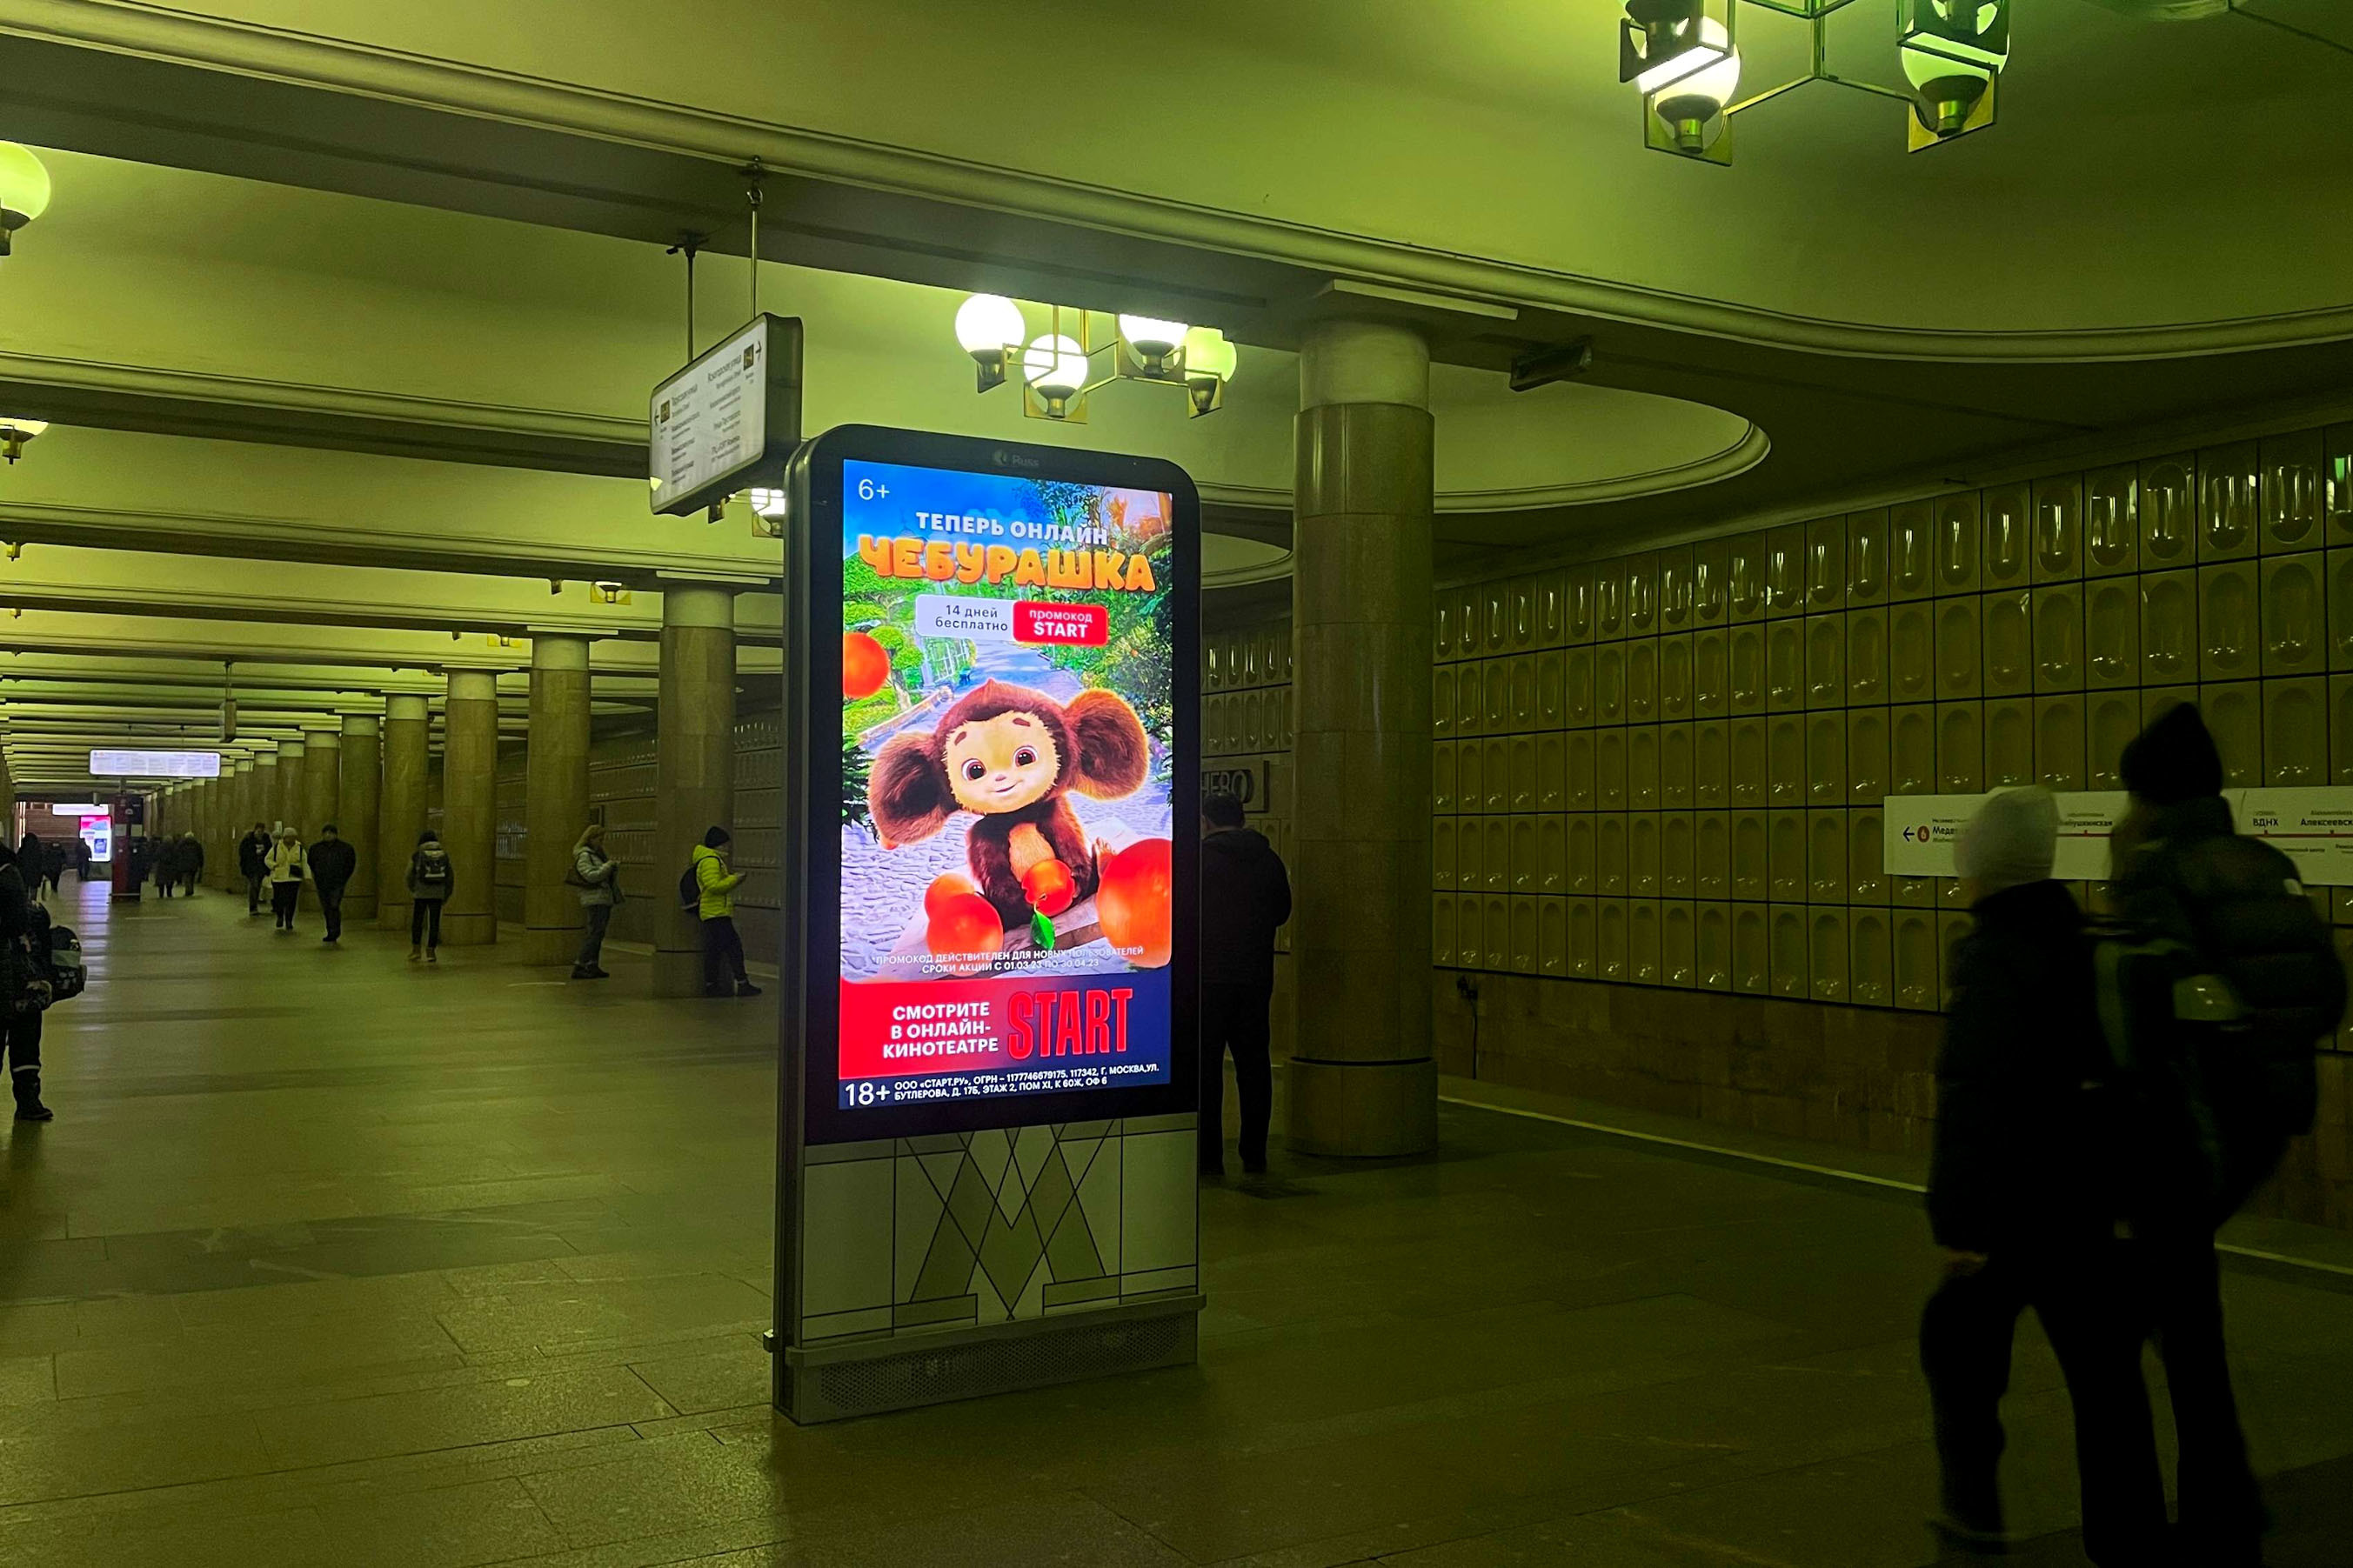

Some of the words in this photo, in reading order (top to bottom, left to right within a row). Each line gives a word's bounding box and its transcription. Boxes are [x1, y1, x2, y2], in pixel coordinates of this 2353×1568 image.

[859, 478, 891, 501] 6+
[916, 512, 1003, 536] ТЕПЕРЬ
[1010, 521, 1108, 545] ОНЛАЙН
[859, 536, 1157, 593] ЧЕБУРАШКА
[946, 604, 960, 617] 14
[965, 606, 999, 619] дней
[1029, 609, 1093, 624] промокод
[935, 616, 1008, 632] бесплатно
[1033, 624, 1089, 639] START
[2253, 817, 2279, 827] ВДНХ
[935, 951, 1010, 964] ДЕЙСТВИТЕЛЕН
[1012, 950, 1031, 961] ДЛЯ
[1033, 949, 1066, 960] НОВЫХ
[921, 964, 956, 974] СРОКИ
[959, 962, 993, 973] АКЦИИ
[994, 962, 1002, 971] С
[1004, 960, 1042, 971] 01.03.23
[892, 1001, 991, 1021] СМОТРИТЕ
[891, 1024, 903, 1040] В
[906, 1019, 992, 1038] ОНЛАЙН-
[1007, 987, 1133, 1060] START
[883, 1038, 999, 1059] КИНОТЕАТРЕ
[894, 1081, 918, 1091] ООО
[973, 1074, 998, 1084] ОГРН
[983, 1084, 1007, 1095] ЭТАЖ
[1019, 1081, 1040, 1091] ПОМ
[1086, 1077, 1100, 1087] ОФ
[1101, 1076, 1107, 1085] 6
[845, 1082, 892, 1107] 18+
